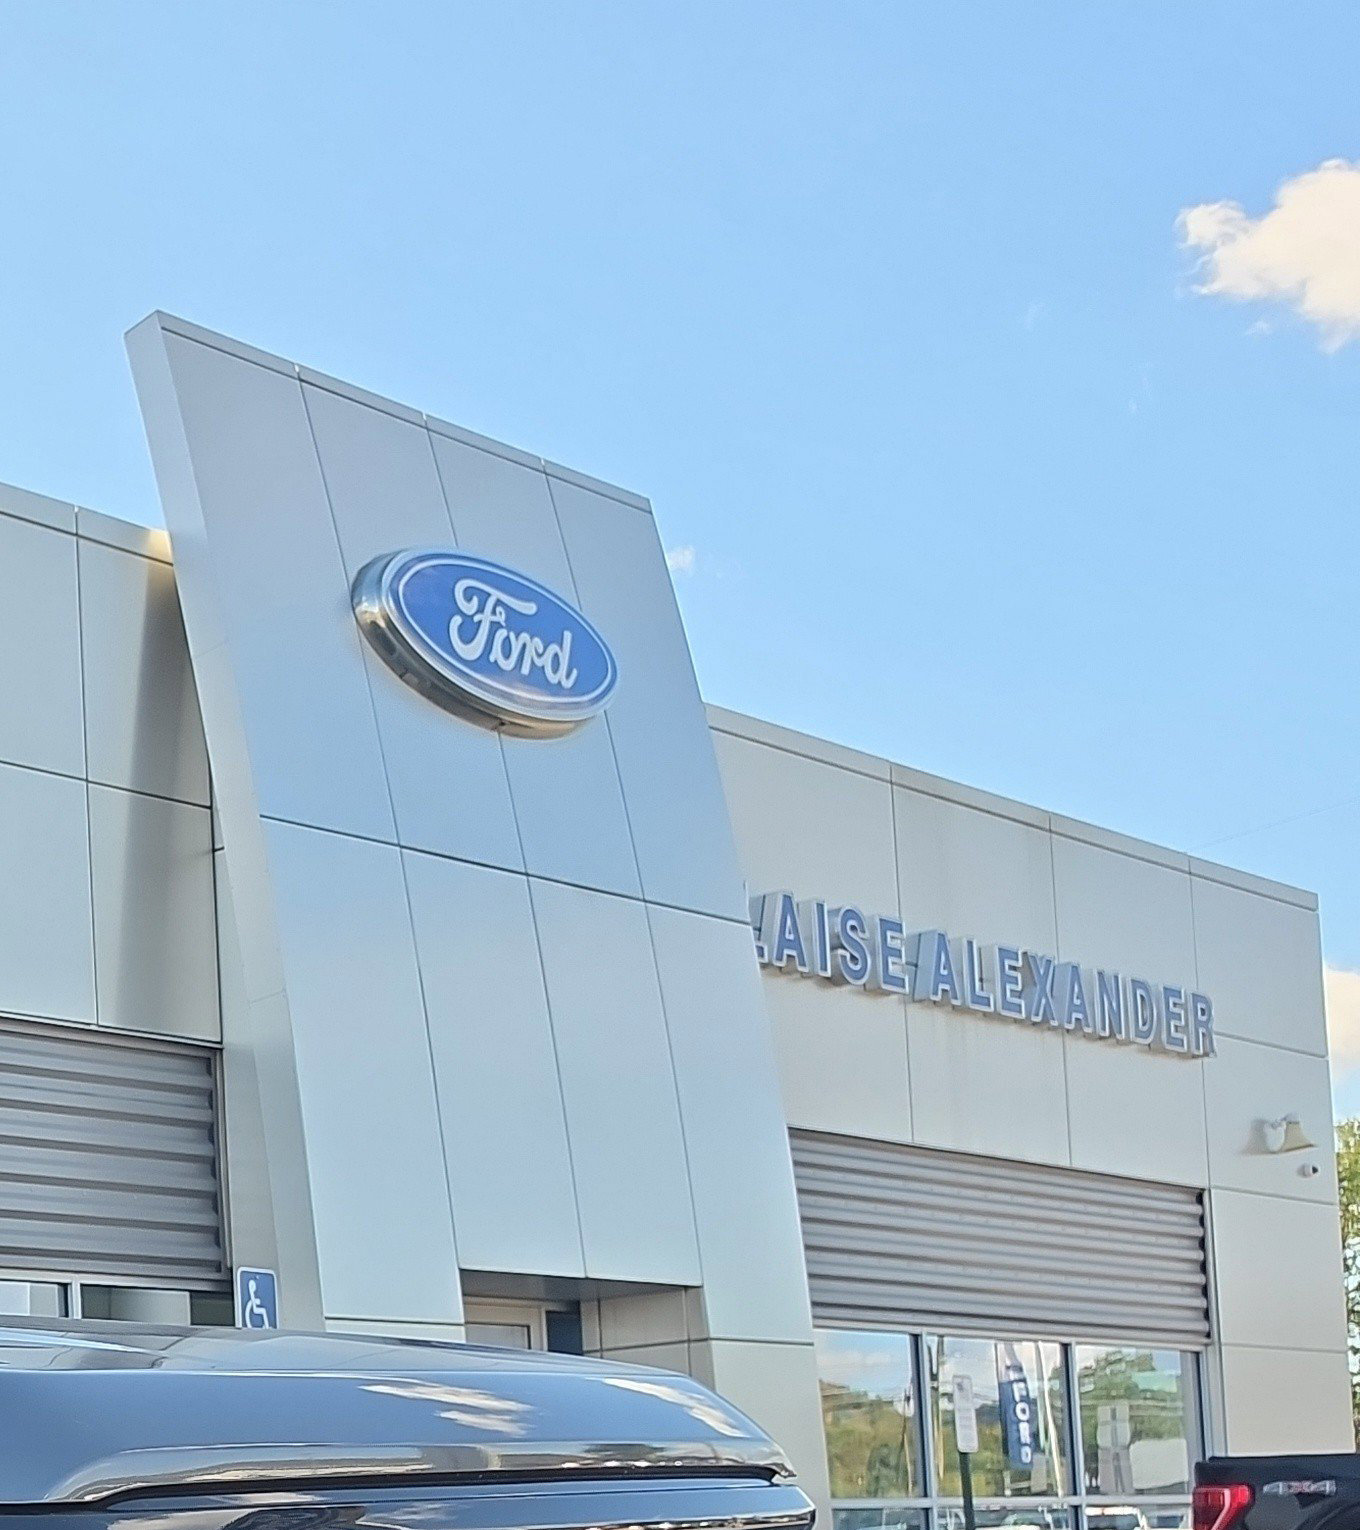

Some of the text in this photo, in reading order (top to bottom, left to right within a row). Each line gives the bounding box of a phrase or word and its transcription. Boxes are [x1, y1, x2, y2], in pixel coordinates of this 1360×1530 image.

[449, 578, 578, 690] Ford
[754, 889, 1218, 1058] AISE ALEXANDER
